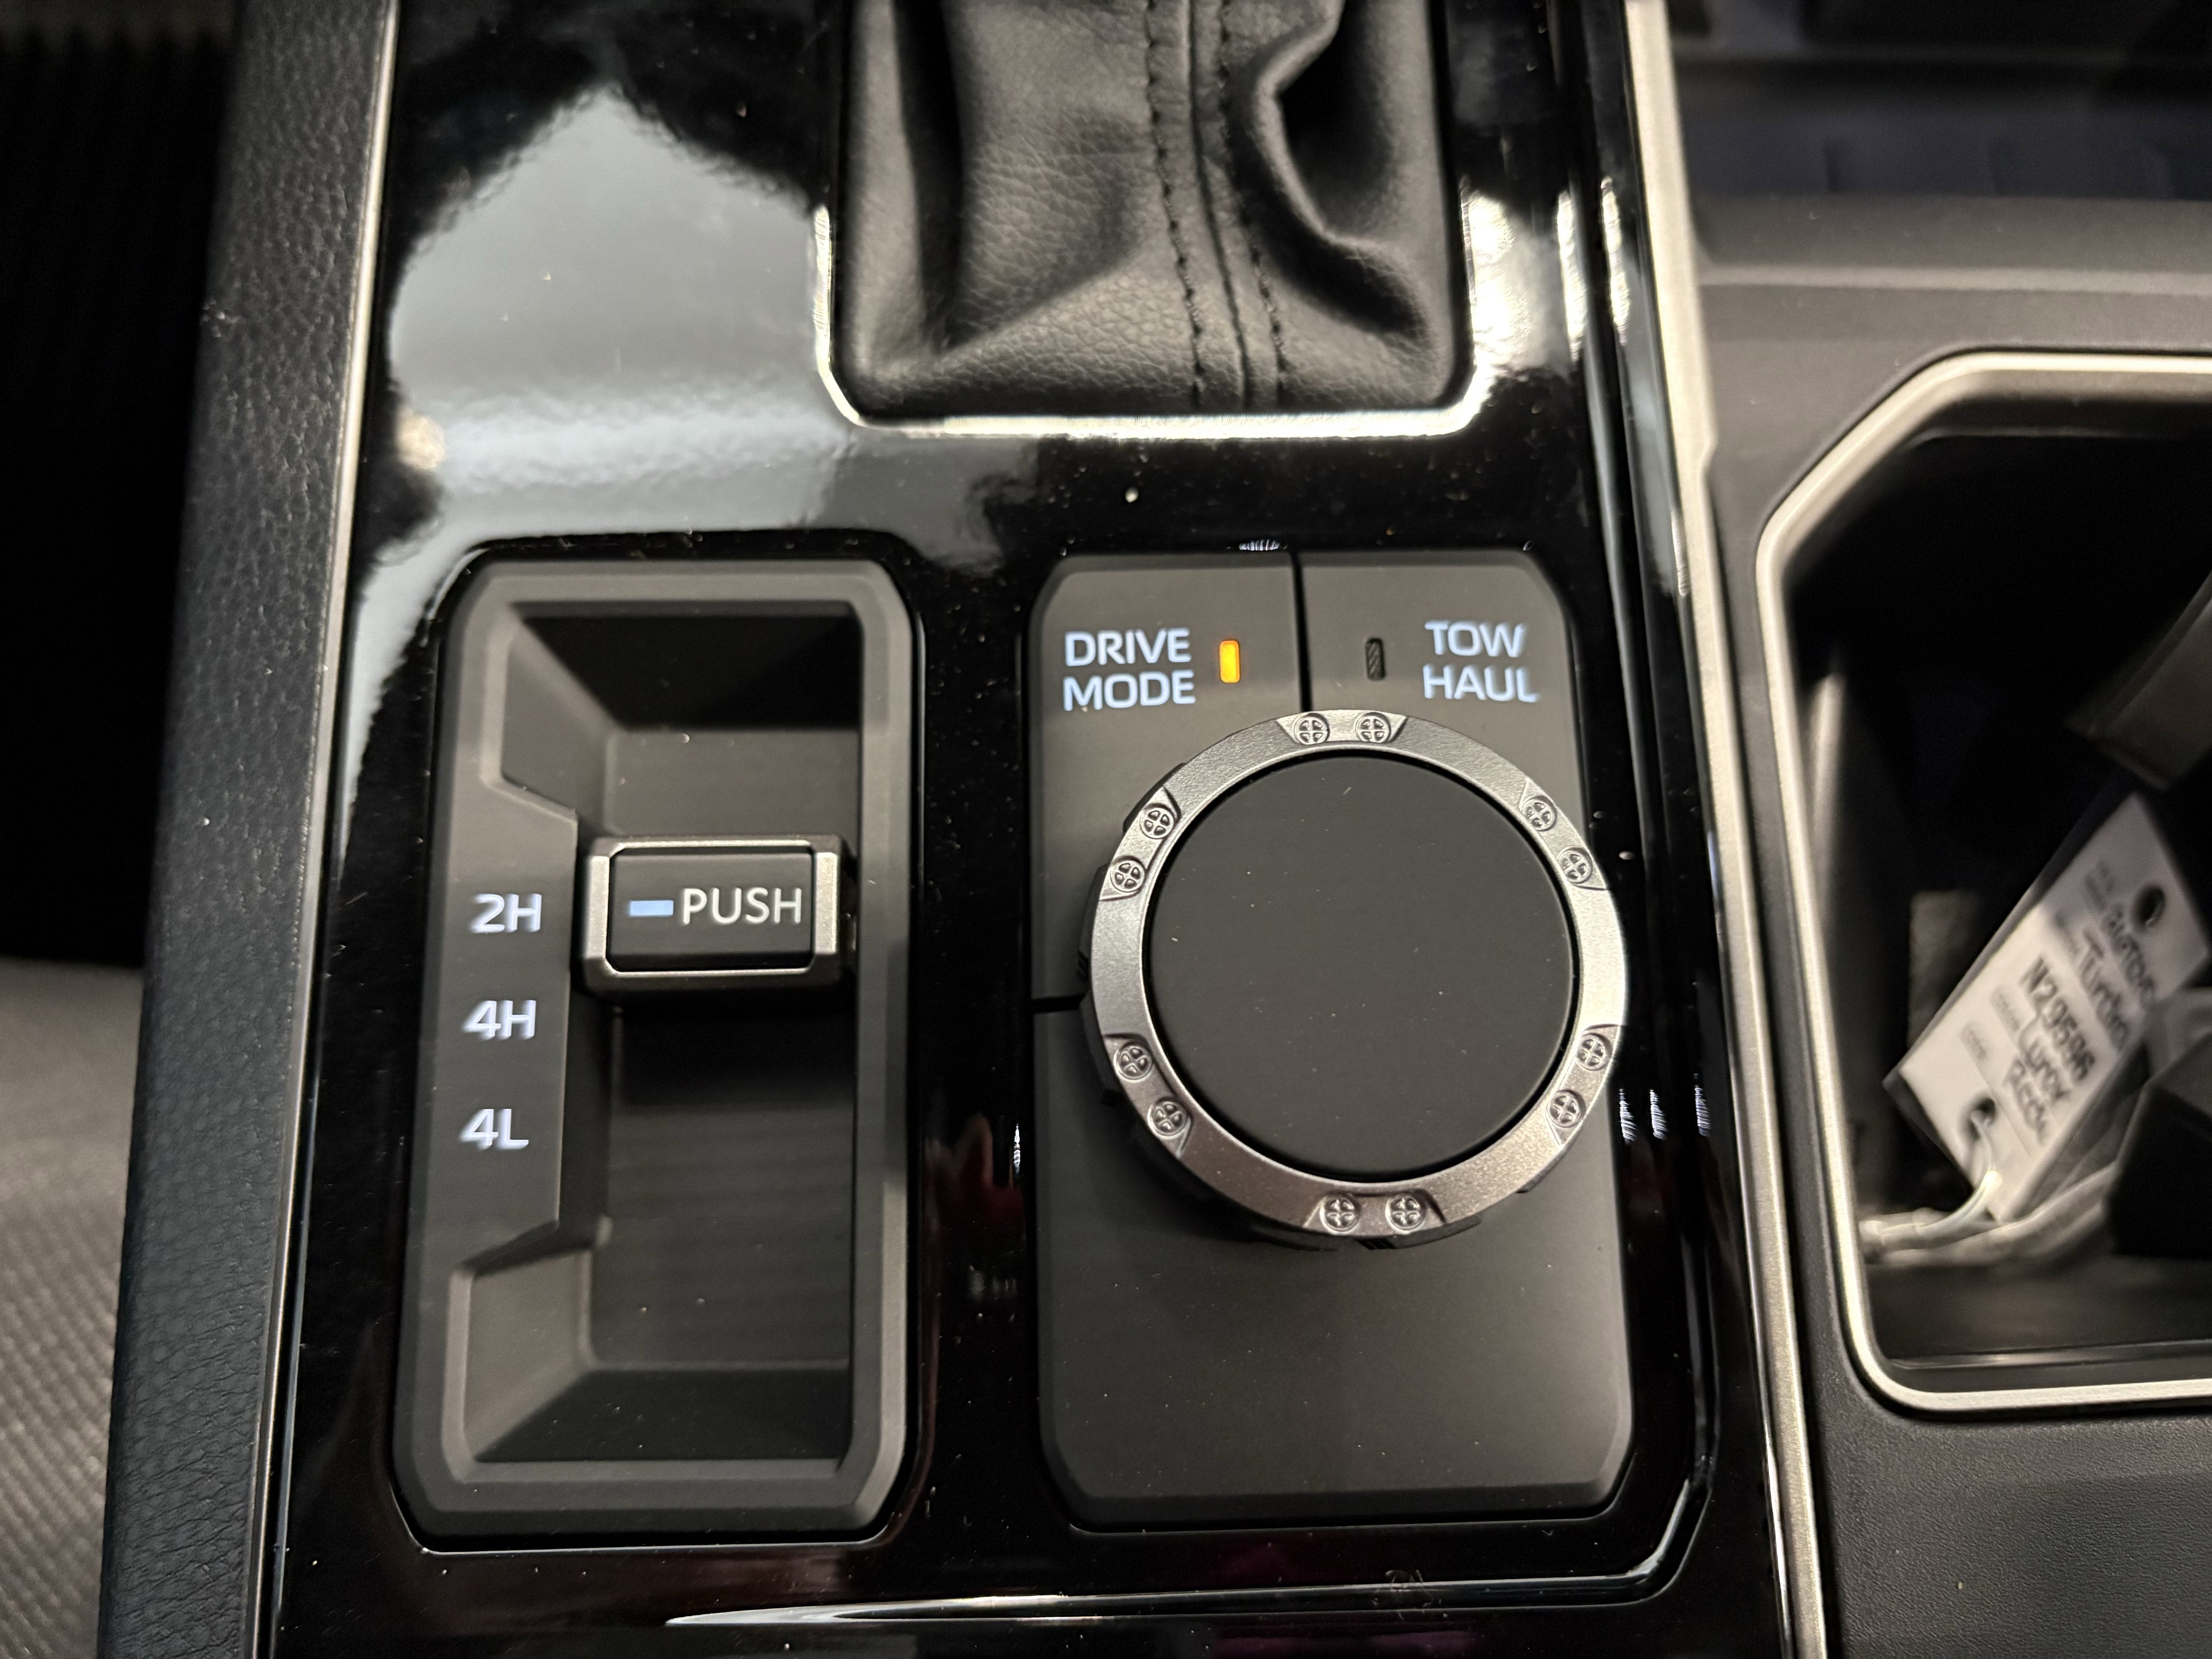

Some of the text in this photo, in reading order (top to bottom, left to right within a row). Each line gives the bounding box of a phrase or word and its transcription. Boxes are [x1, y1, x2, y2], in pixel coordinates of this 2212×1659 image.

[1065, 629, 1192, 666] DRIVE
[1425, 622, 1527, 658] TOW
[1064, 670, 1196, 711] MODE
[1423, 665, 1537, 703] HAUL
[471, 893, 542, 933] 2H
[682, 887, 802, 925] PUSH
[463, 1000, 537, 1039] 4H
[460, 1108, 529, 1150] 4L
